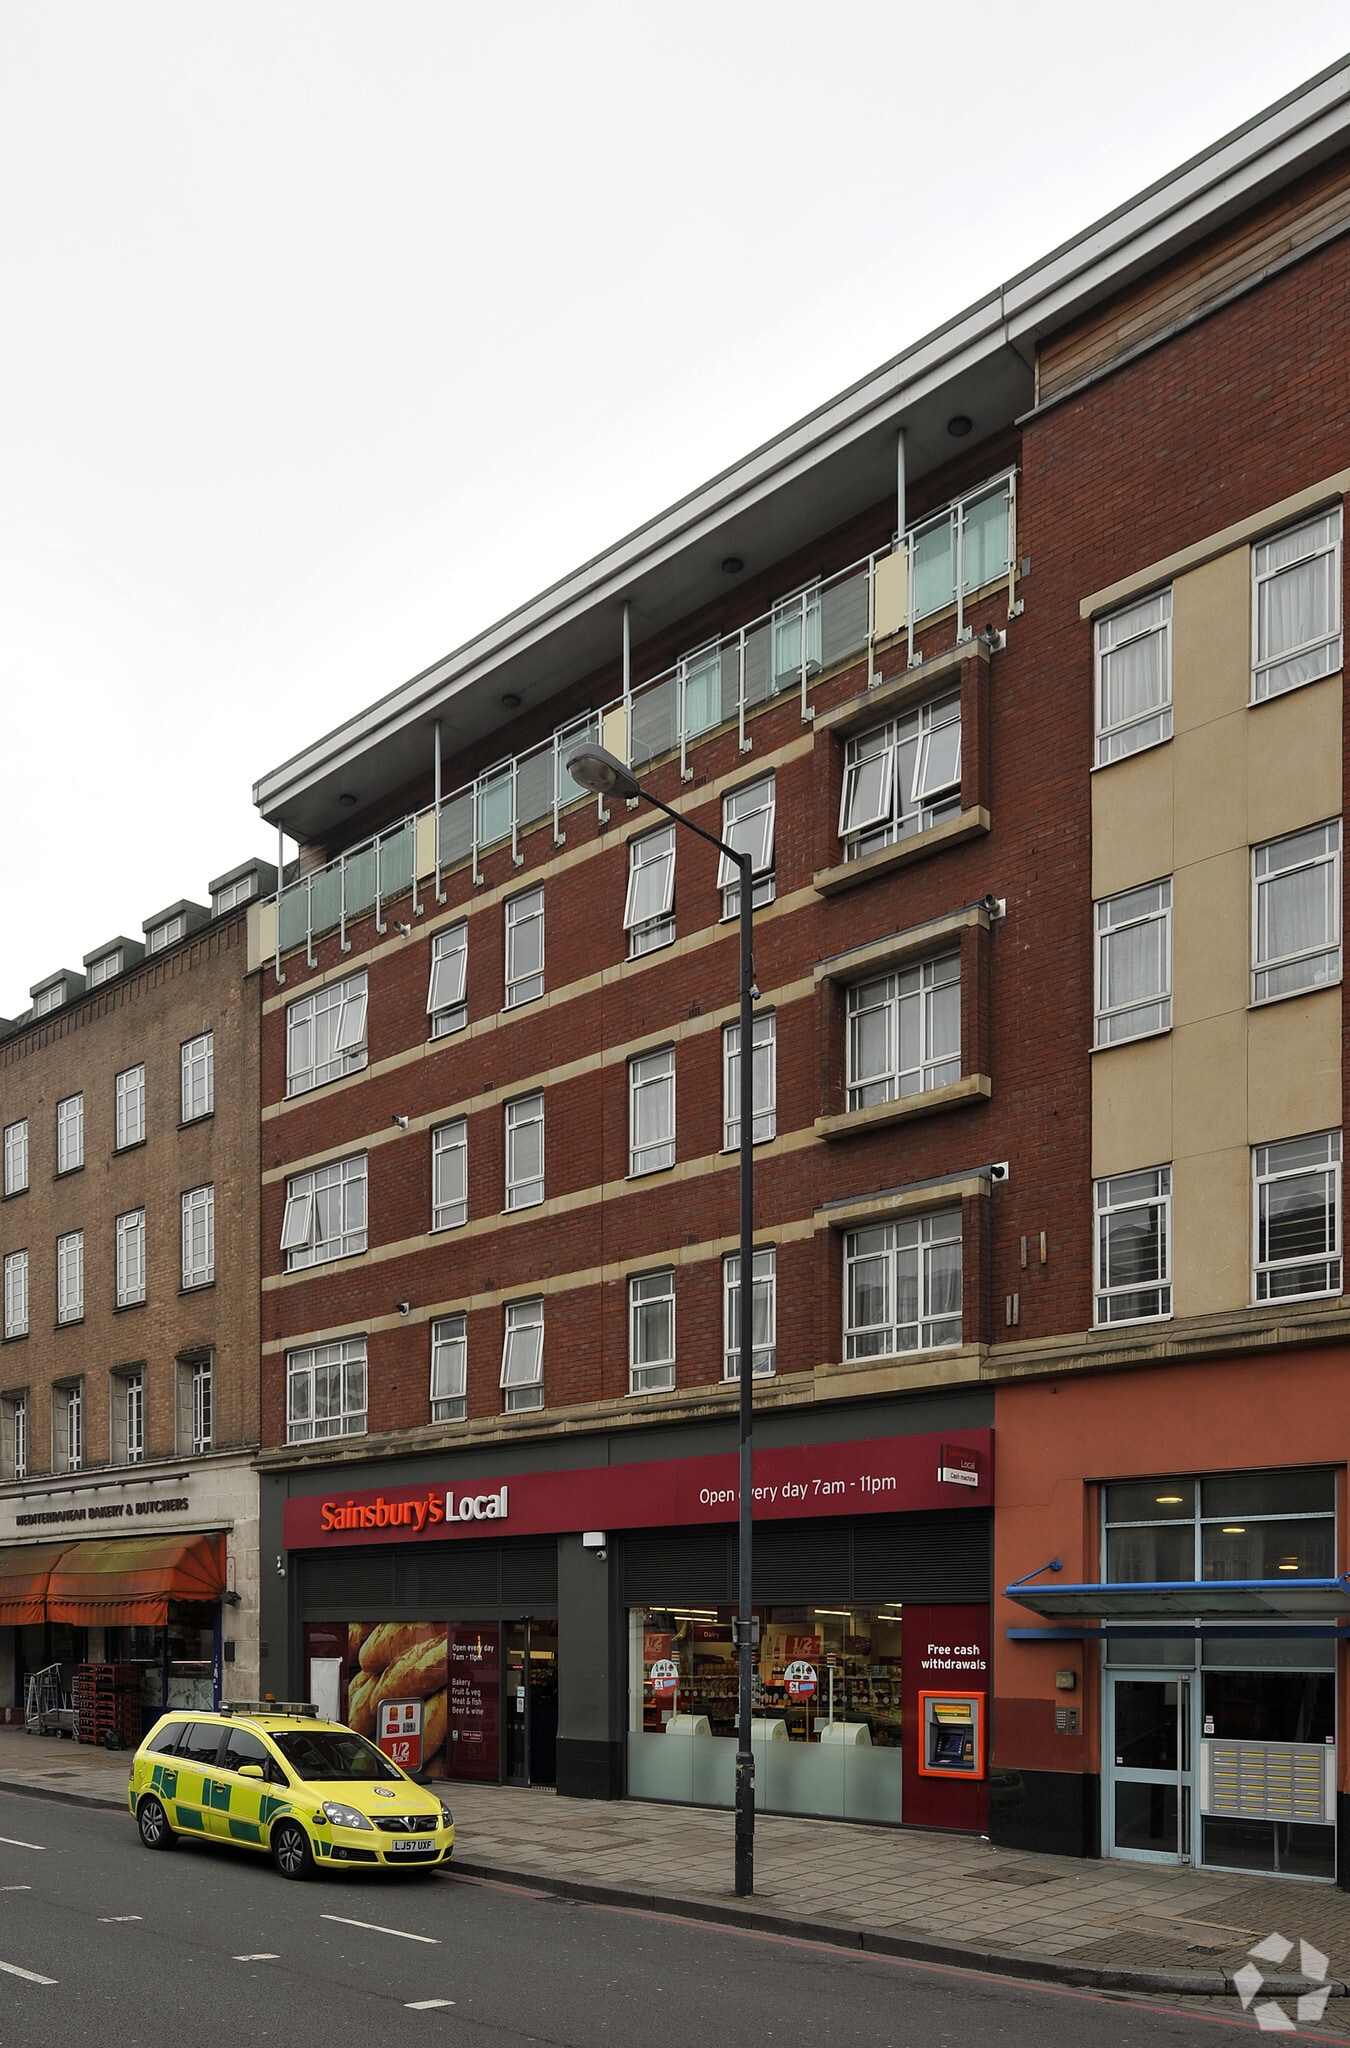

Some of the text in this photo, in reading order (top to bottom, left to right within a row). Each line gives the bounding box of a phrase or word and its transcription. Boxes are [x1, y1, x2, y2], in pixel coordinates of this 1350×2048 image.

[960, 1459, 975, 1469] Local
[699, 1488, 735, 1506] Open
[738, 1486, 778, 1502] ery
[781, 1481, 808, 1500] day
[812, 1479, 845, 1495] 7am
[860, 1475, 896, 1494] 11pm
[16, 1497, 189, 1526] MEDITERRANEAN BAKERY & BUTCHERS
[321, 1485, 508, 1531] Sainsbury's Local
[703, 1631, 720, 1639] Dairy
[793, 1637, 812, 1649] 1/2
[452, 1644, 494, 1653] Open every day
[927, 1644, 980, 1655] Free cash
[452, 1653, 465, 1661] 7am
[470, 1653, 483, 1662] 11pm
[921, 1659, 987, 1670] withdrawals
[452, 1678, 471, 1687] Bakery
[452, 1687, 465, 1695] Fruit
[471, 1689, 481, 1697] veg
[452, 1697, 465, 1705] Meat
[466, 1707, 470, 1715] &
[471, 1708, 484, 1716] wine
[391, 1742, 409, 1757] 1/2
[394, 1841, 432, 1850] LJ57 UXF
